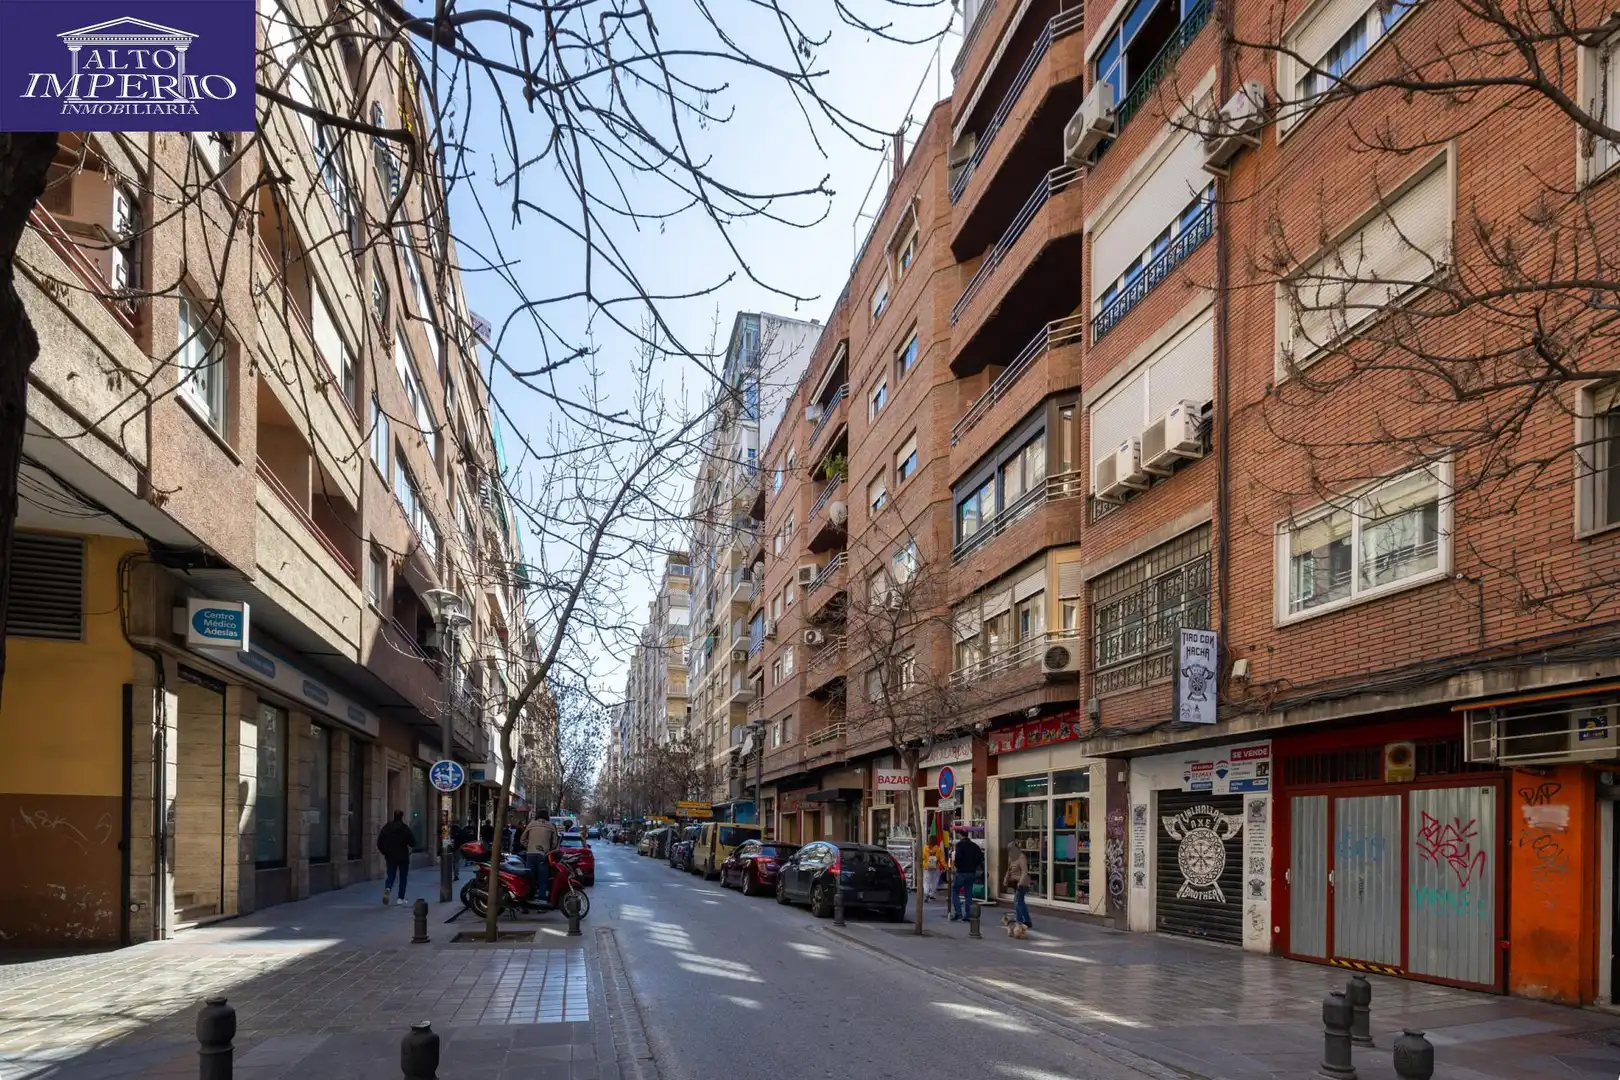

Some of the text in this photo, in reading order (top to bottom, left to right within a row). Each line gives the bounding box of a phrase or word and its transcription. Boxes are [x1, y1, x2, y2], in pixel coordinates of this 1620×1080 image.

[204, 611, 235, 620] Centro
[203, 620, 236, 629] Médico
[204, 628, 238, 637] Adeslas
[1182, 632, 1215, 649] TIRO CON
[1186, 646, 1210, 661] HACHA
[1243, 748, 1269, 757] VENDE
[878, 776, 911, 784] BAZAR
[1180, 804, 1220, 823] VALHALLA
[1190, 818, 1211, 829] AXE
[1181, 886, 1221, 903] BROTHER
